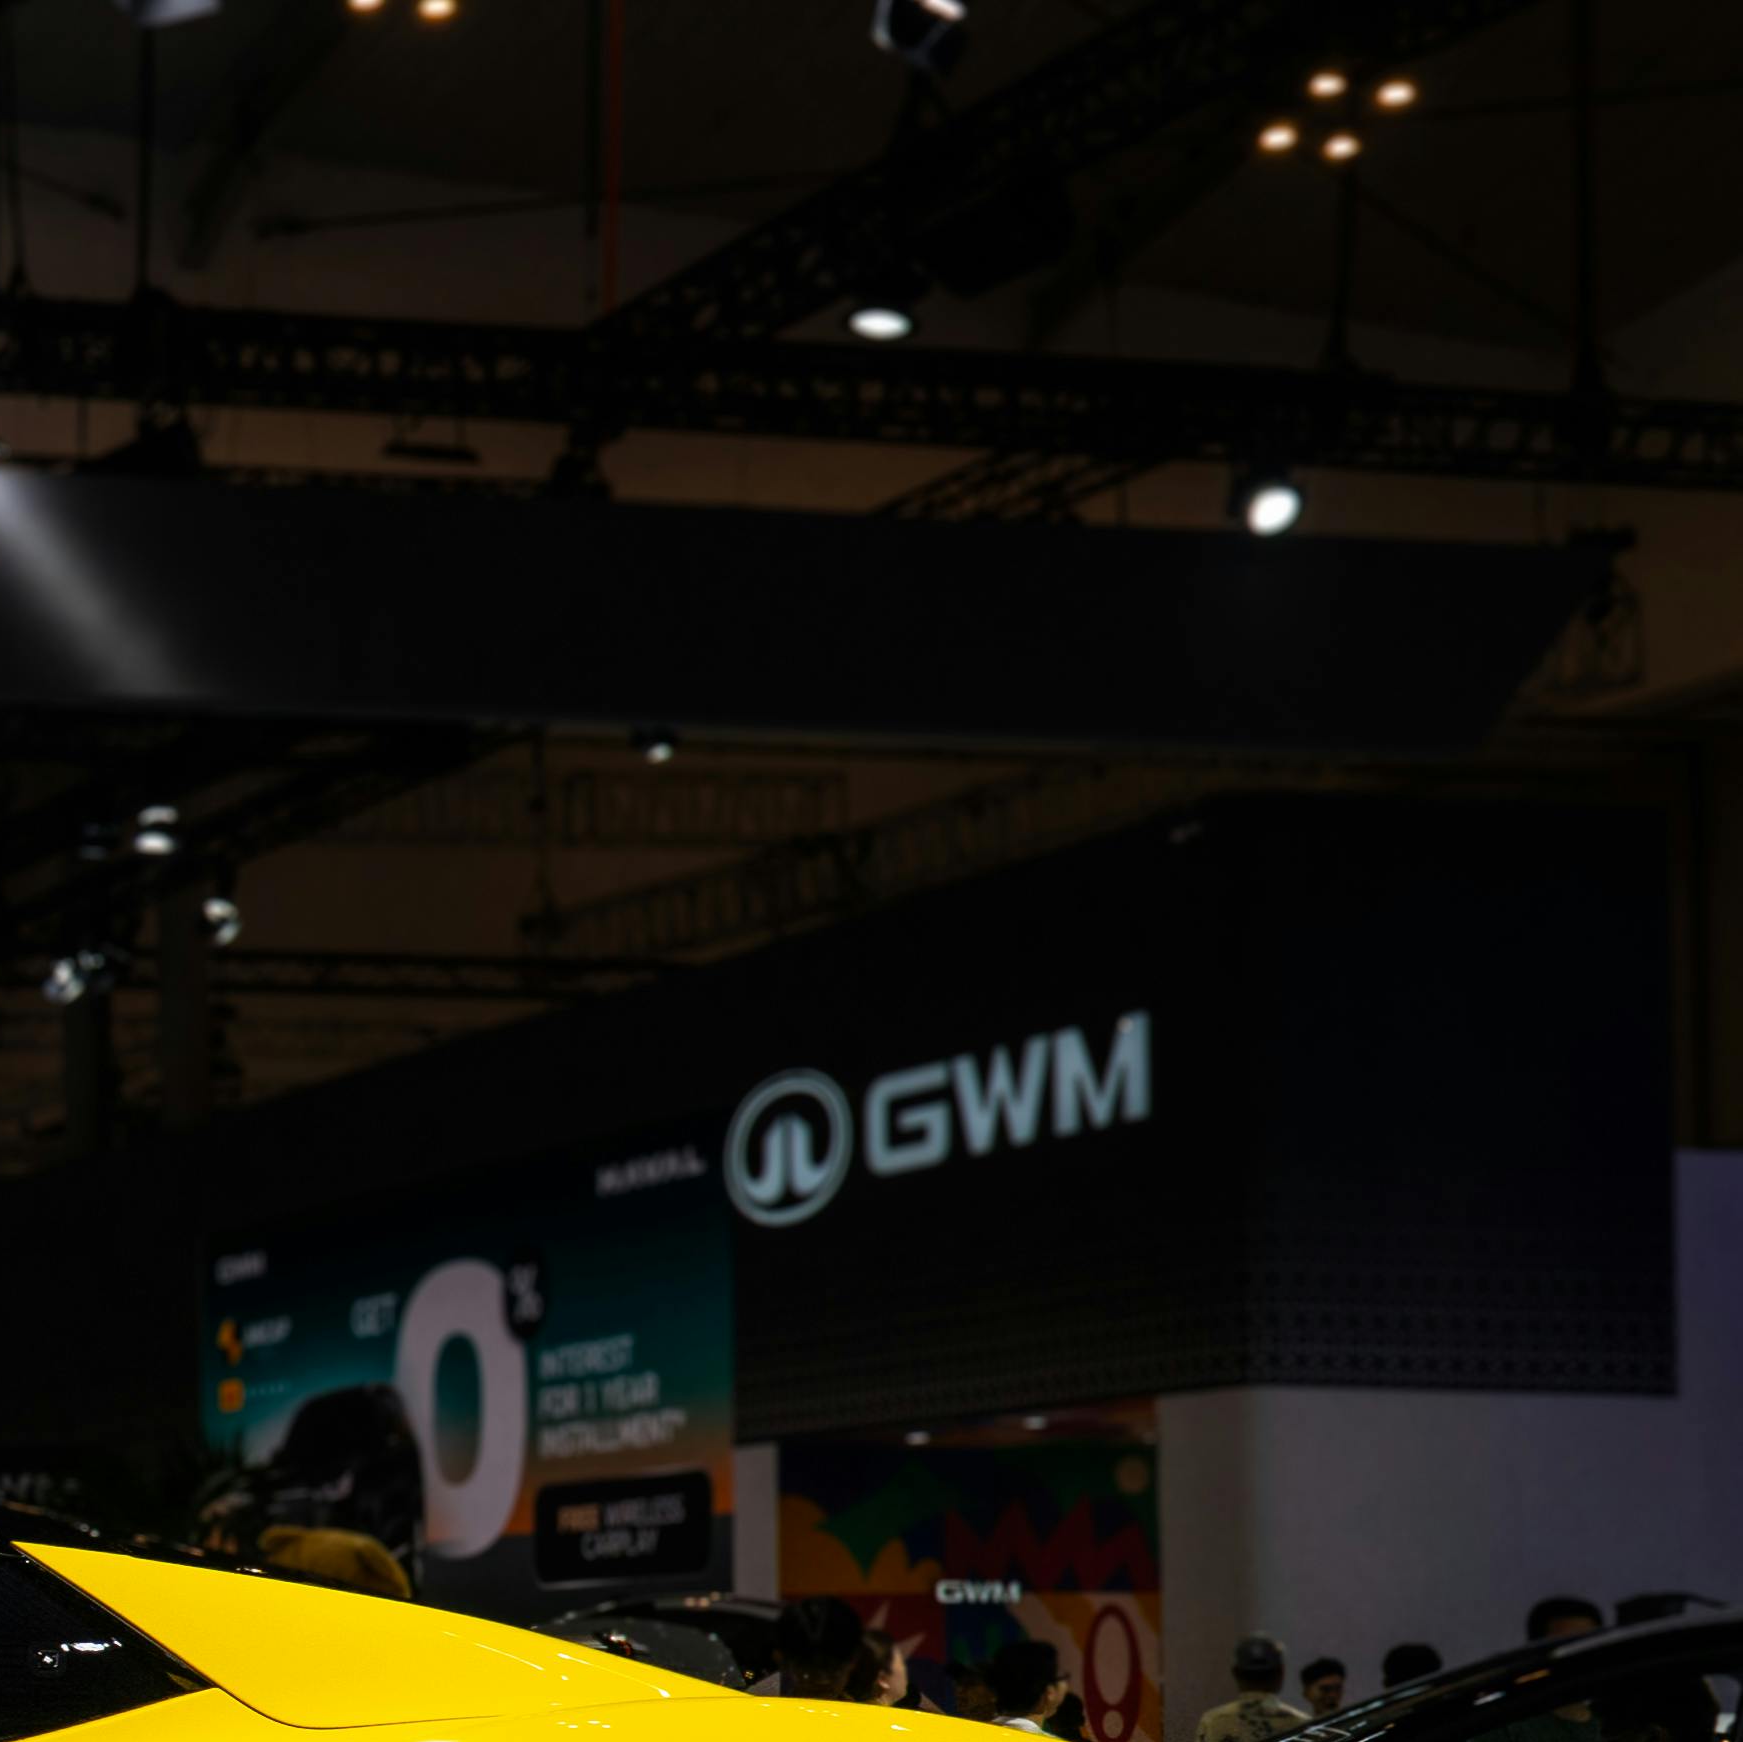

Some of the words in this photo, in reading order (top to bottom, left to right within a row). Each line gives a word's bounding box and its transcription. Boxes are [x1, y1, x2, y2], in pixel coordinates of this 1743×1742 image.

[864, 1007, 1153, 1178] GWM
[538, 1333, 635, 1380] INTEREST
[934, 1578, 1022, 1604] GWM
